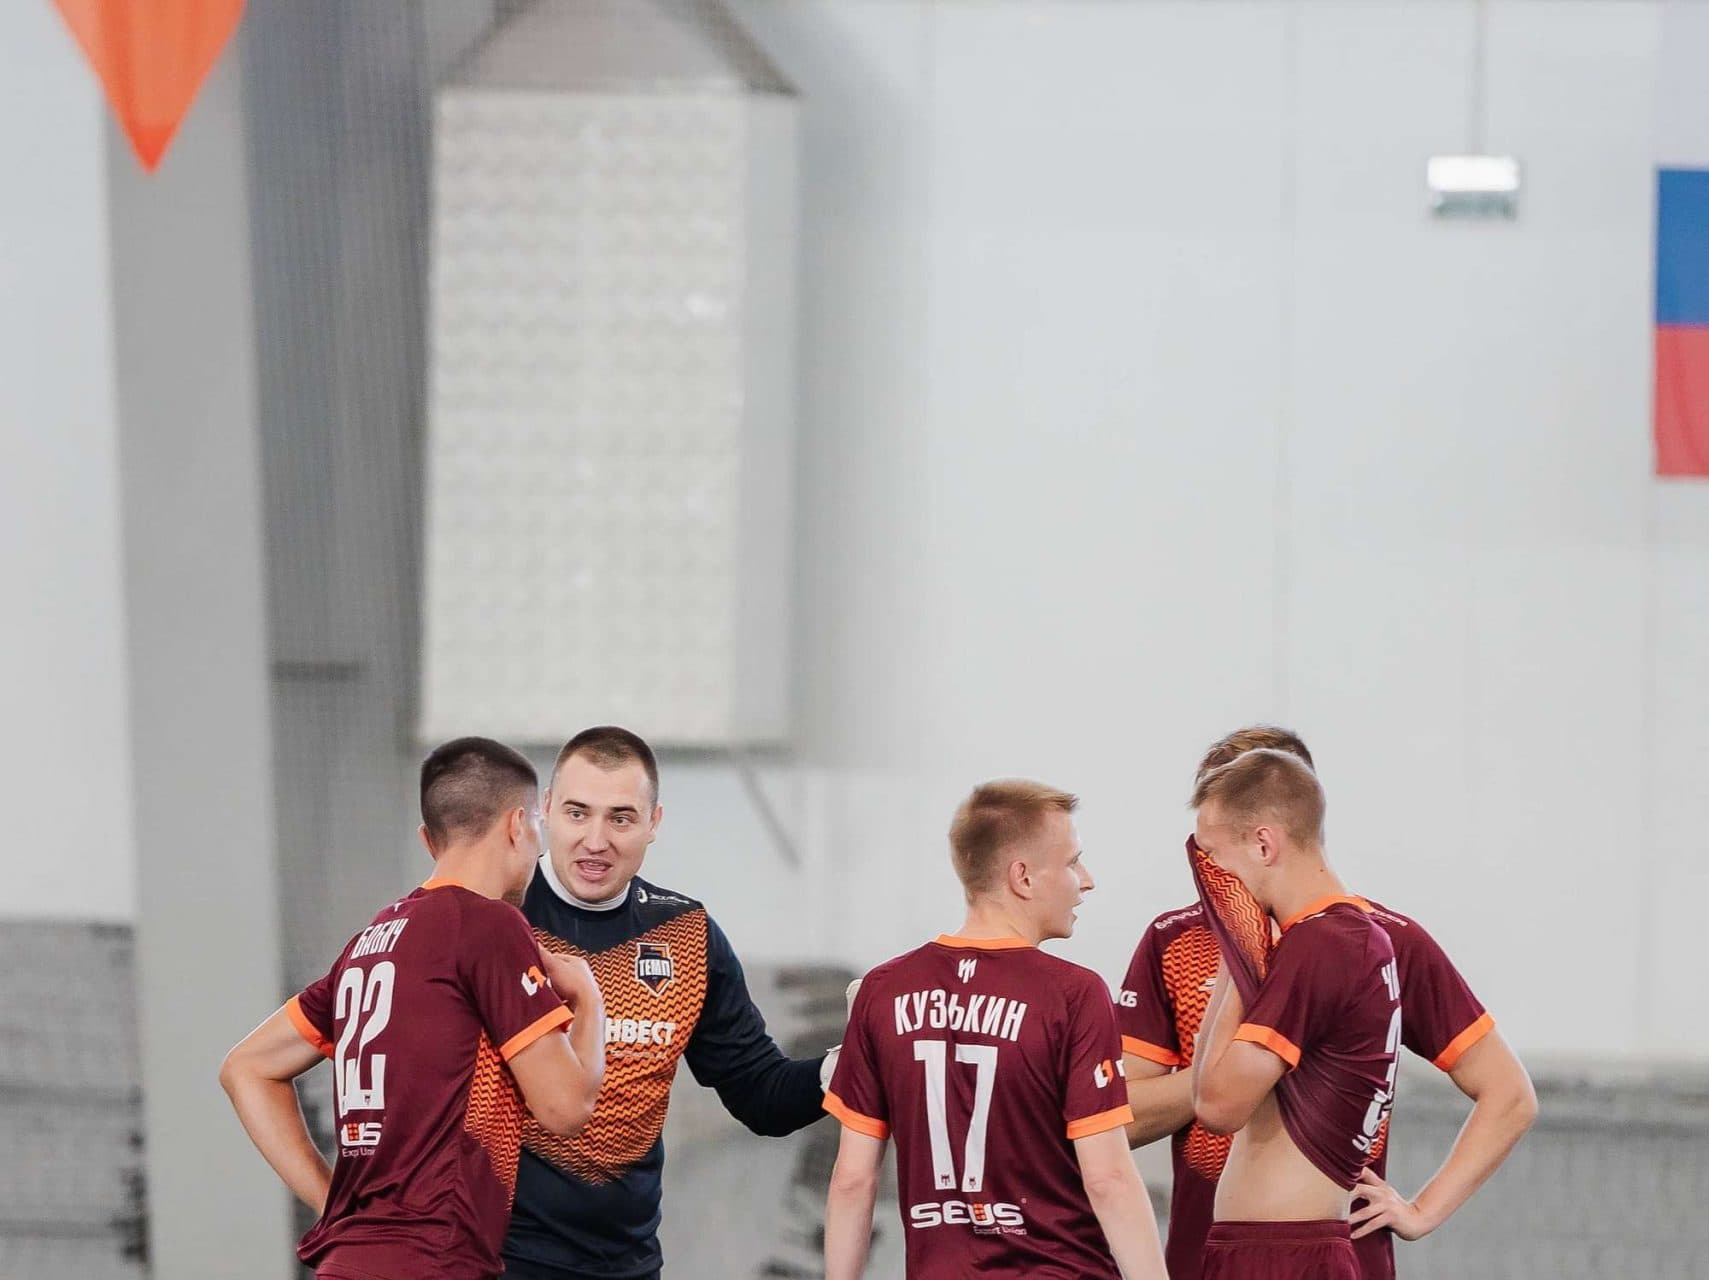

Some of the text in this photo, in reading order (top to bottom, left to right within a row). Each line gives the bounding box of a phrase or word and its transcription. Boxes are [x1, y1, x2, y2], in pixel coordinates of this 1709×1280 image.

[604, 1017, 677, 1046] НВЕСТ
[893, 988, 1028, 1042] КУЗЬКИН
[335, 961, 396, 1118] 22
[341, 1122, 382, 1147] US
[913, 1039, 999, 1193] 17
[910, 1200, 1025, 1229] SEUS
